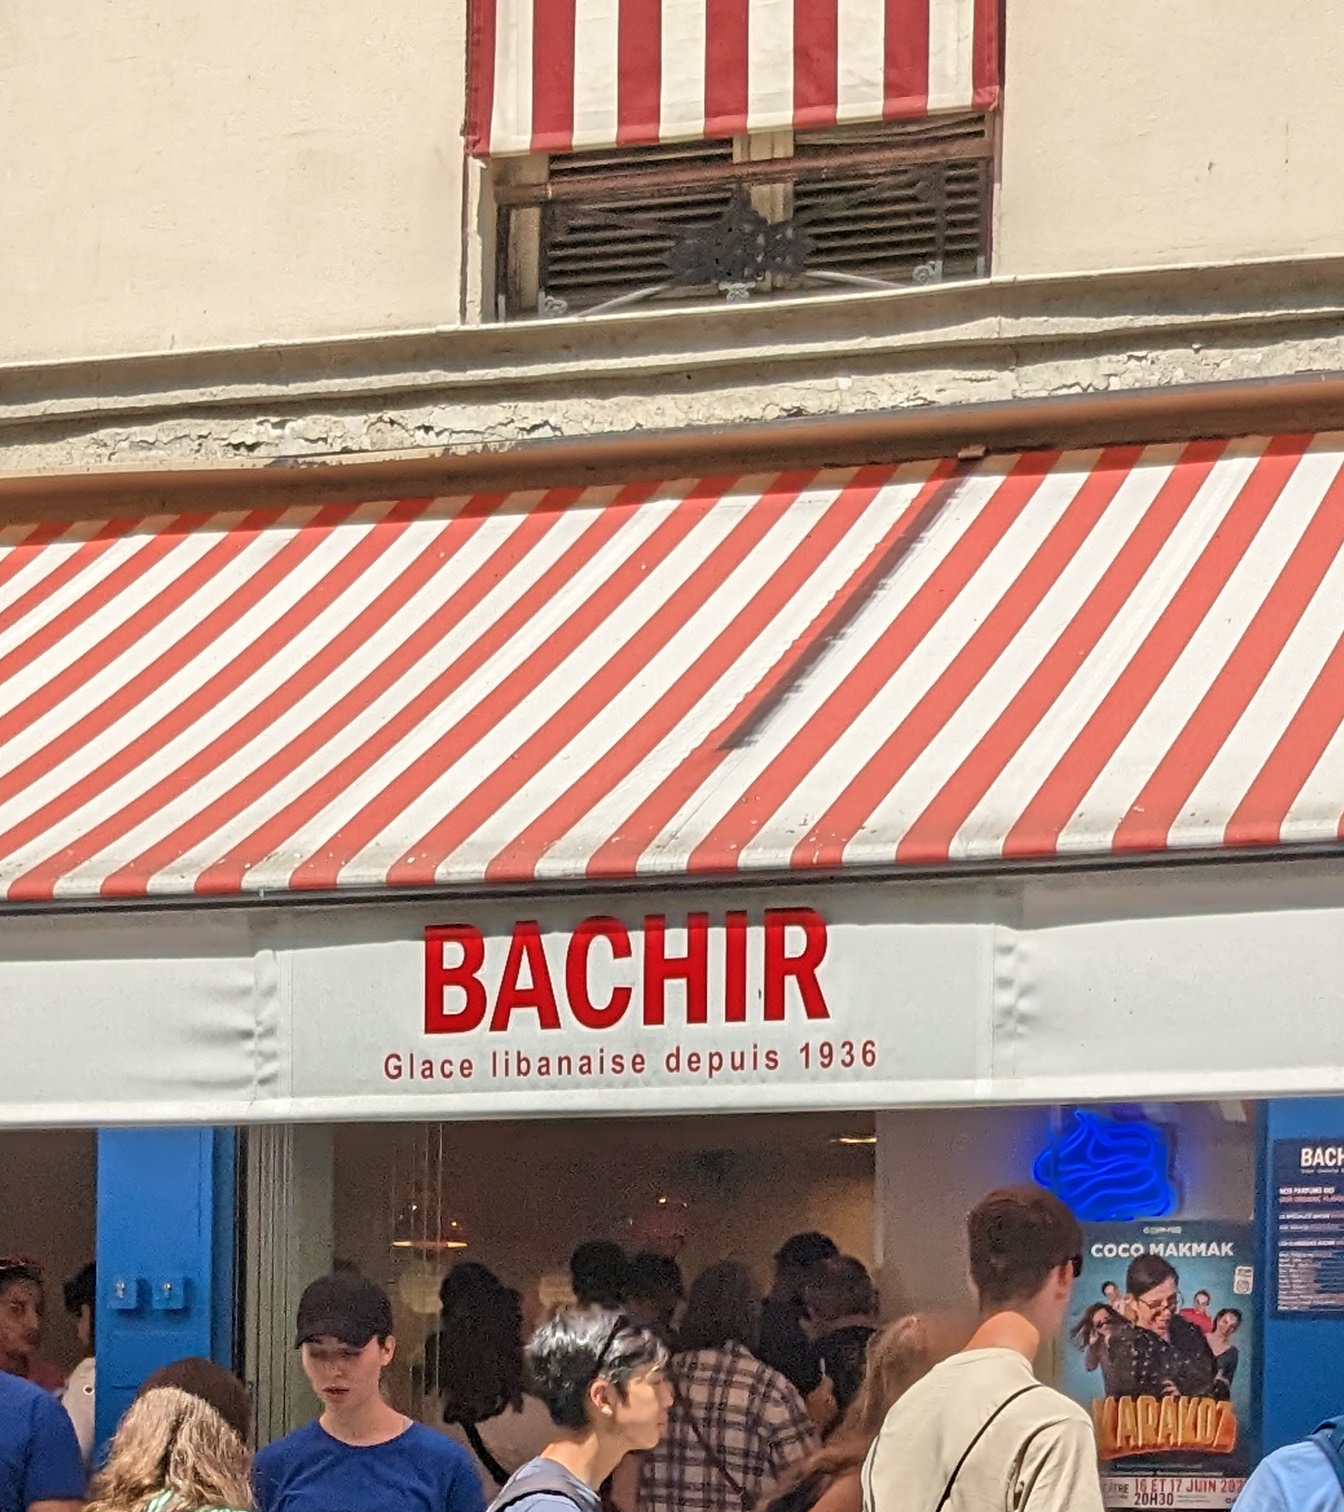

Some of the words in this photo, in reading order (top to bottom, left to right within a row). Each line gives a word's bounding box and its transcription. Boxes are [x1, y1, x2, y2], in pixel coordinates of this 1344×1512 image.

[423, 905, 832, 1036] BACHIR
[382, 1051, 475, 1081] Glace
[490, 1046, 647, 1079] libanaise
[663, 1041, 780, 1079] depuis
[798, 1039, 878, 1070] 1936
[1090, 1242, 1143, 1258] COCO
[1149, 1241, 1235, 1257] MAKMAK
[1150, 1478, 1167, 1493] ET
[1170, 1478, 1183, 1493] 17
[1185, 1478, 1217, 1493] JUIN
[1133, 1492, 1174, 1506] 20H30
